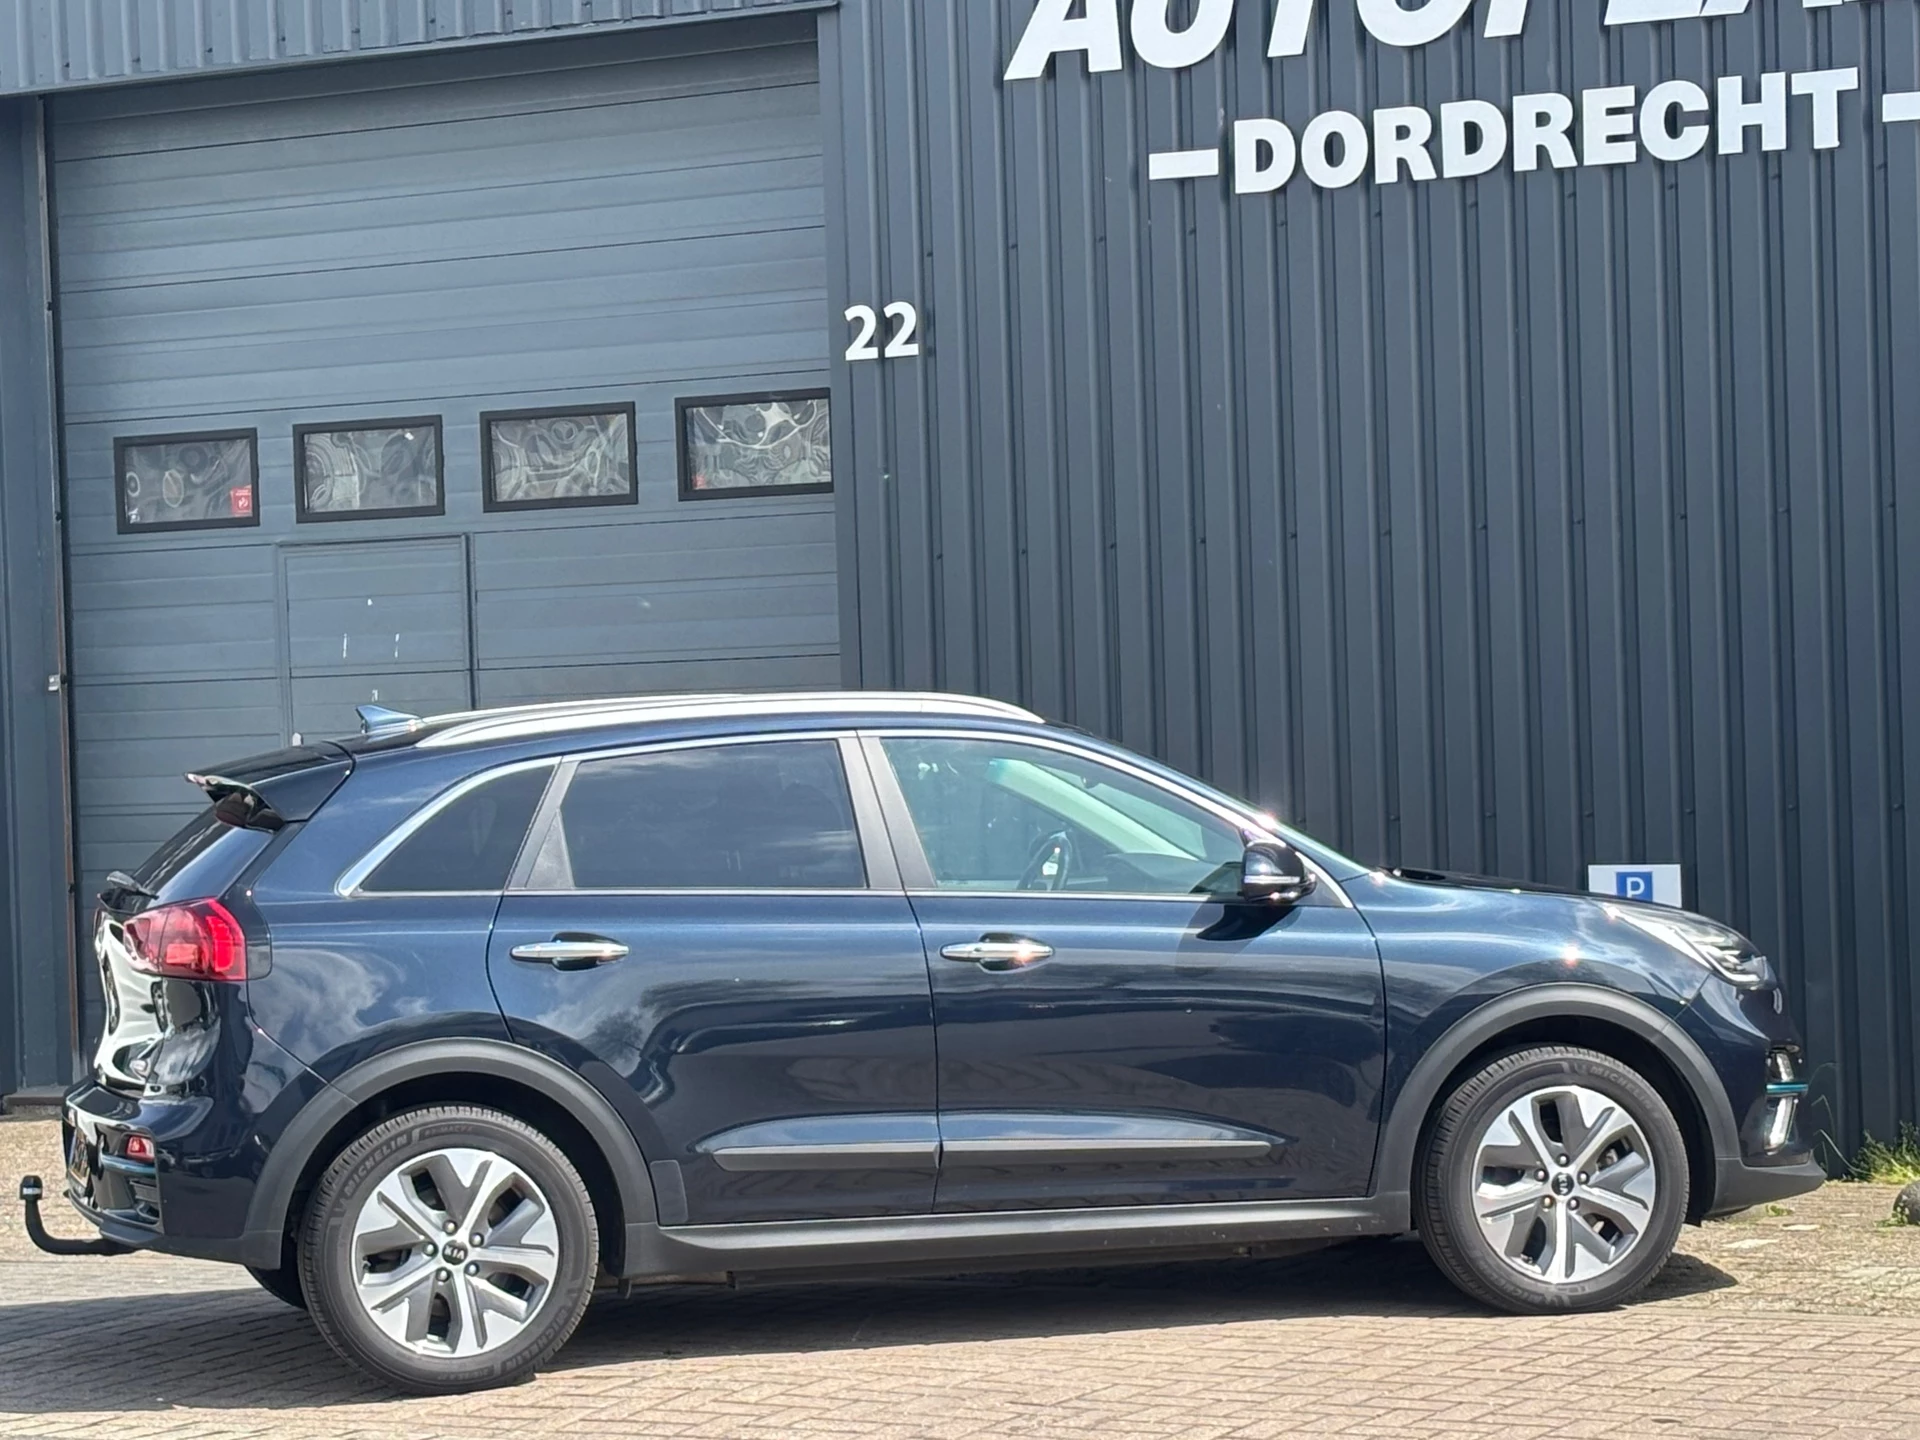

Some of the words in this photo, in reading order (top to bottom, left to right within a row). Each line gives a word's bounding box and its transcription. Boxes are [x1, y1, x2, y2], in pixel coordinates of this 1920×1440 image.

[1233, 66, 1859, 194] DORDRECHT
[844, 301, 919, 361] 22
[1626, 877, 1645, 898] P
[343, 1133, 409, 1198] MICHELIN
[443, 1245, 465, 1260] KIA
